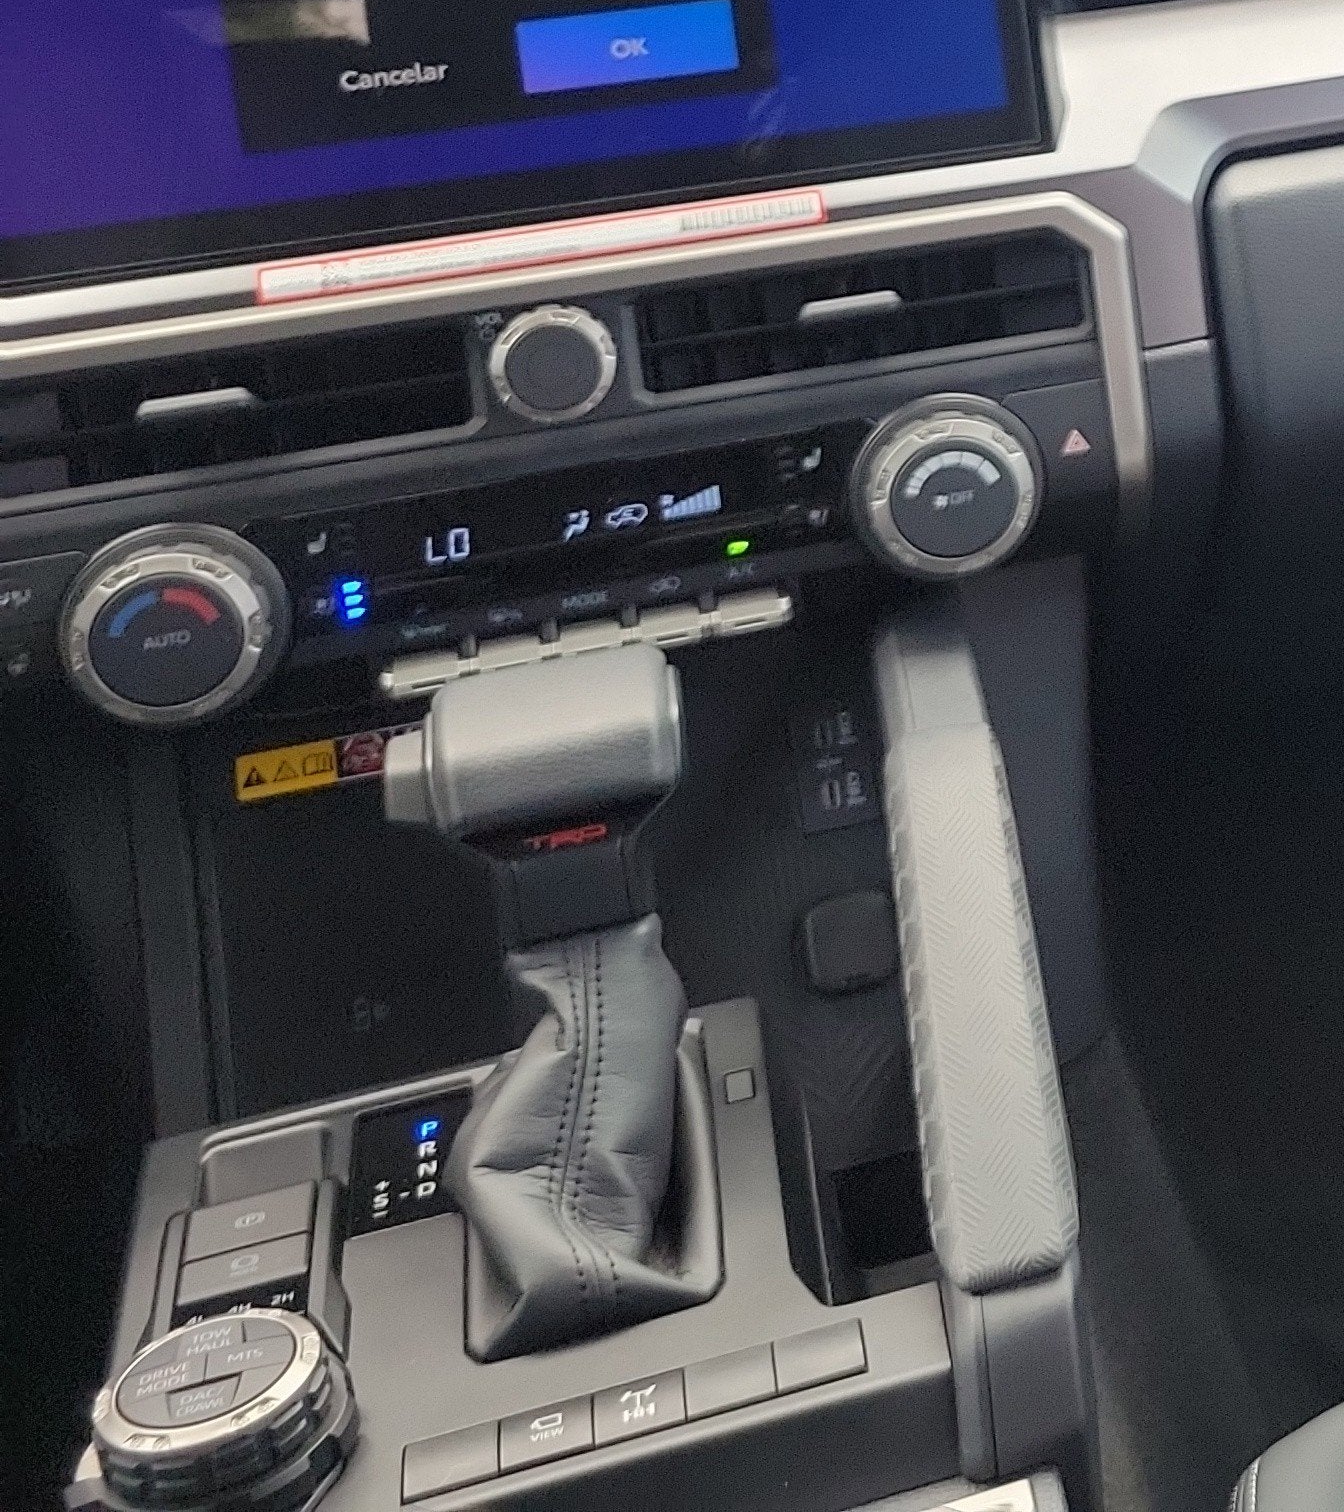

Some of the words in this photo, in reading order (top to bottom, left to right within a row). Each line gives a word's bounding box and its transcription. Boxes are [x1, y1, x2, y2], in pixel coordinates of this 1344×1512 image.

[609, 37, 649, 60] OK
[339, 61, 449, 92] Cancelar
[143, 628, 192, 650] AUTO
[421, 1119, 439, 1139] P
[418, 1140, 437, 1159] R
[417, 1160, 438, 1179] N
[417, 1181, 437, 1199] D
[373, 1193, 389, 1211] S
[270, 1290, 295, 1307] 2H
[193, 1326, 232, 1344] TOW
[186, 1339, 234, 1357] HAUL
[226, 1347, 265, 1364] MTS
[139, 1360, 191, 1387] DRIVE
[135, 1372, 190, 1399] MODE
[175, 1396, 226, 1419] CRAWL
[529, 1425, 565, 1442] VIEW
